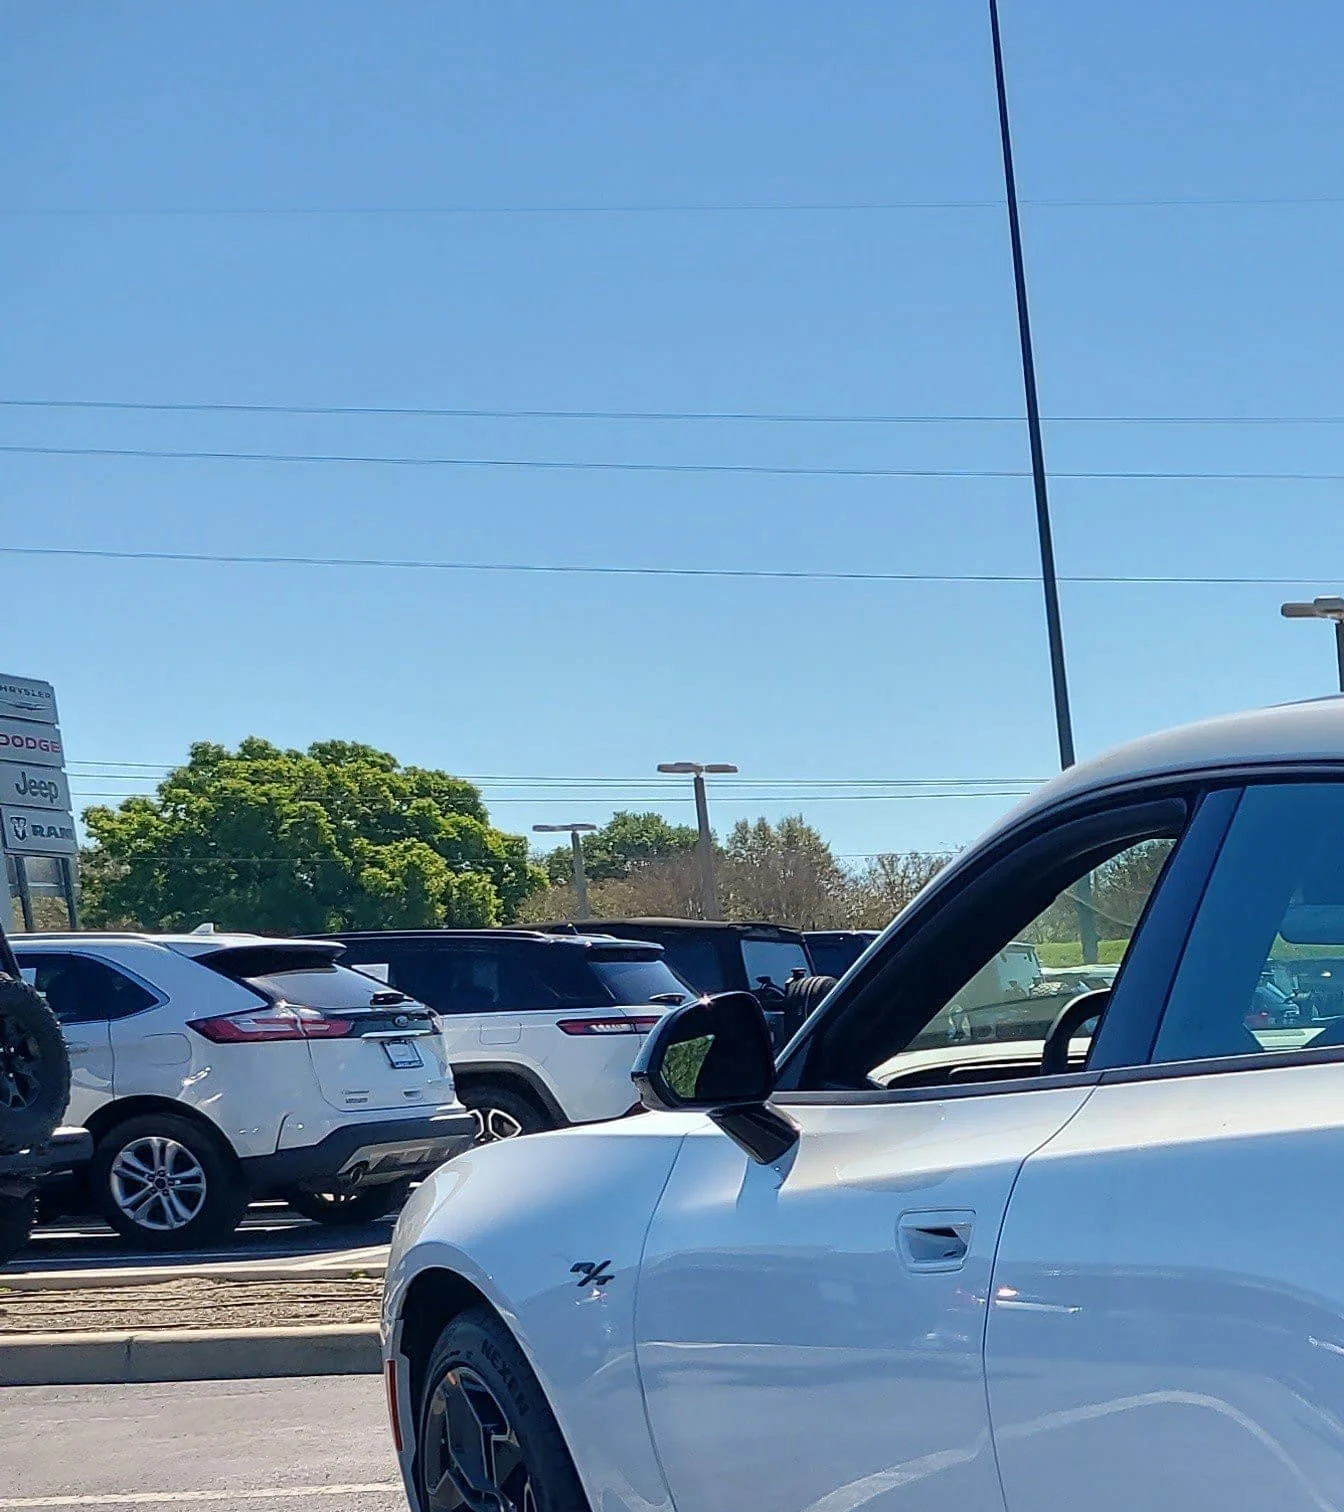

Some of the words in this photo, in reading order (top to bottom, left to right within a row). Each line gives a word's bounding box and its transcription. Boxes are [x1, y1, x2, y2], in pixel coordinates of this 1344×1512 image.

[0, 684, 51, 699] HRYSLER
[0, 733, 61, 754] DODGE
[15, 771, 59, 803] Jeep
[31, 824, 73, 840] RAM
